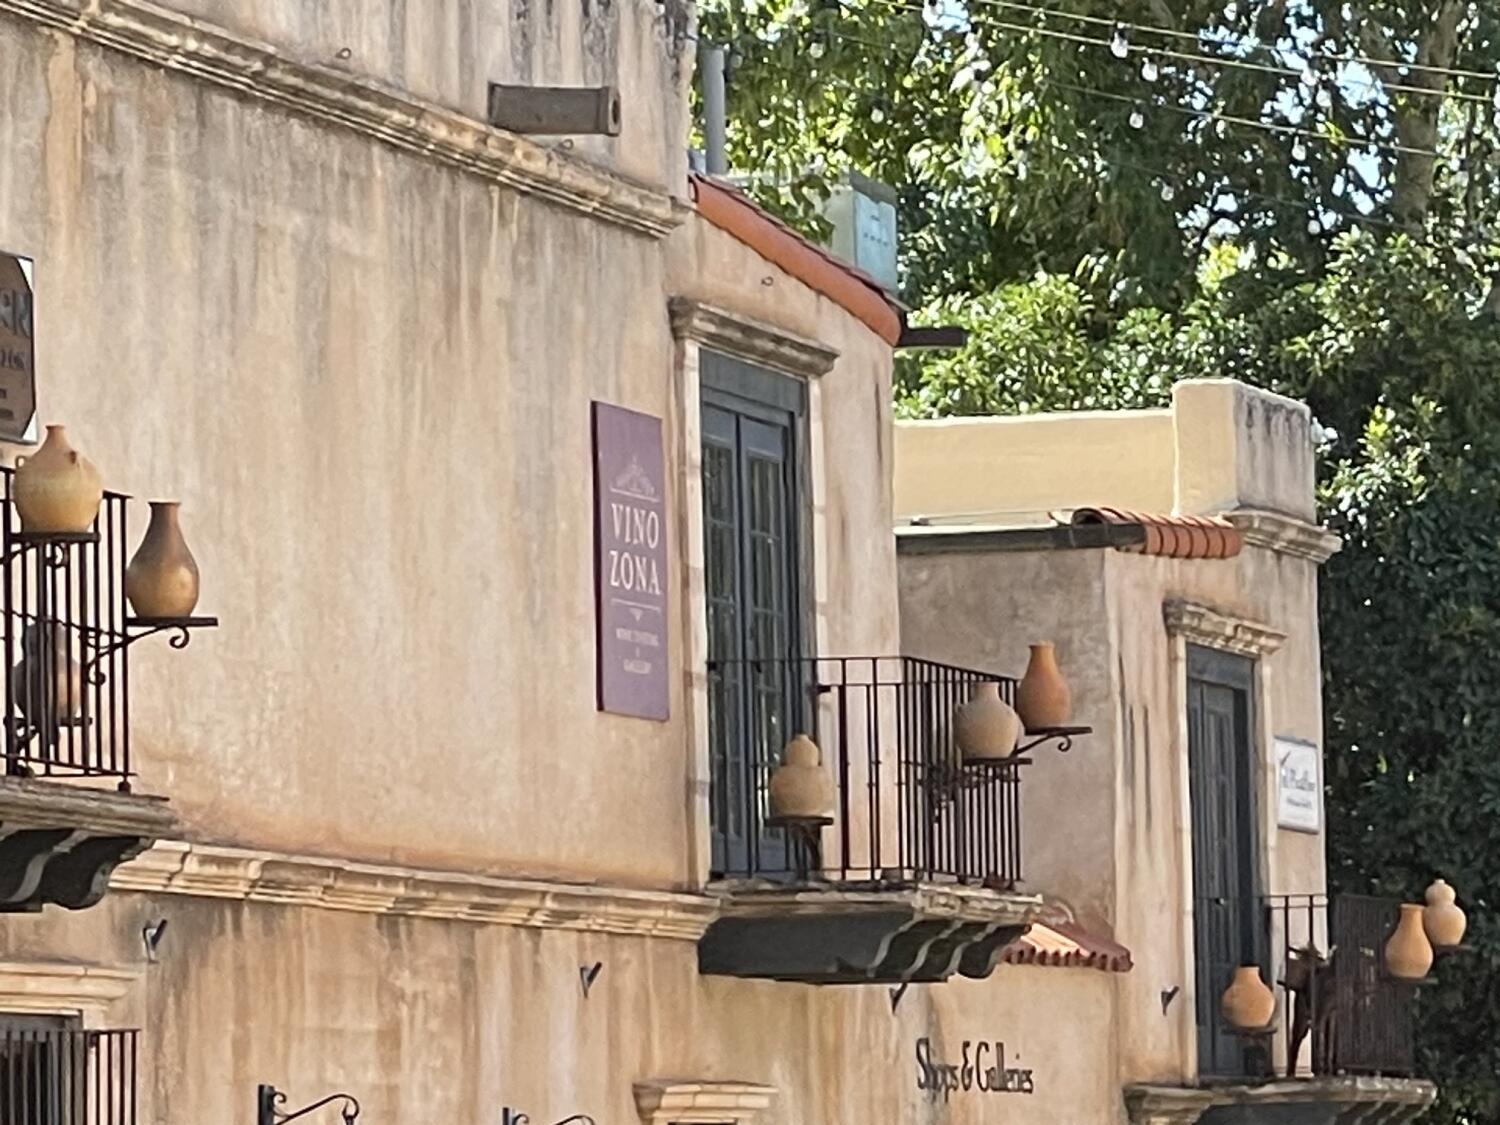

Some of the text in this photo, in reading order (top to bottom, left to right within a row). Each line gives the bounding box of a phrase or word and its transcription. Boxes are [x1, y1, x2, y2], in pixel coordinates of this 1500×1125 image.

[611, 503, 660, 549] VINO
[609, 550, 662, 595] ZONA
[961, 1040, 974, 1092] &
